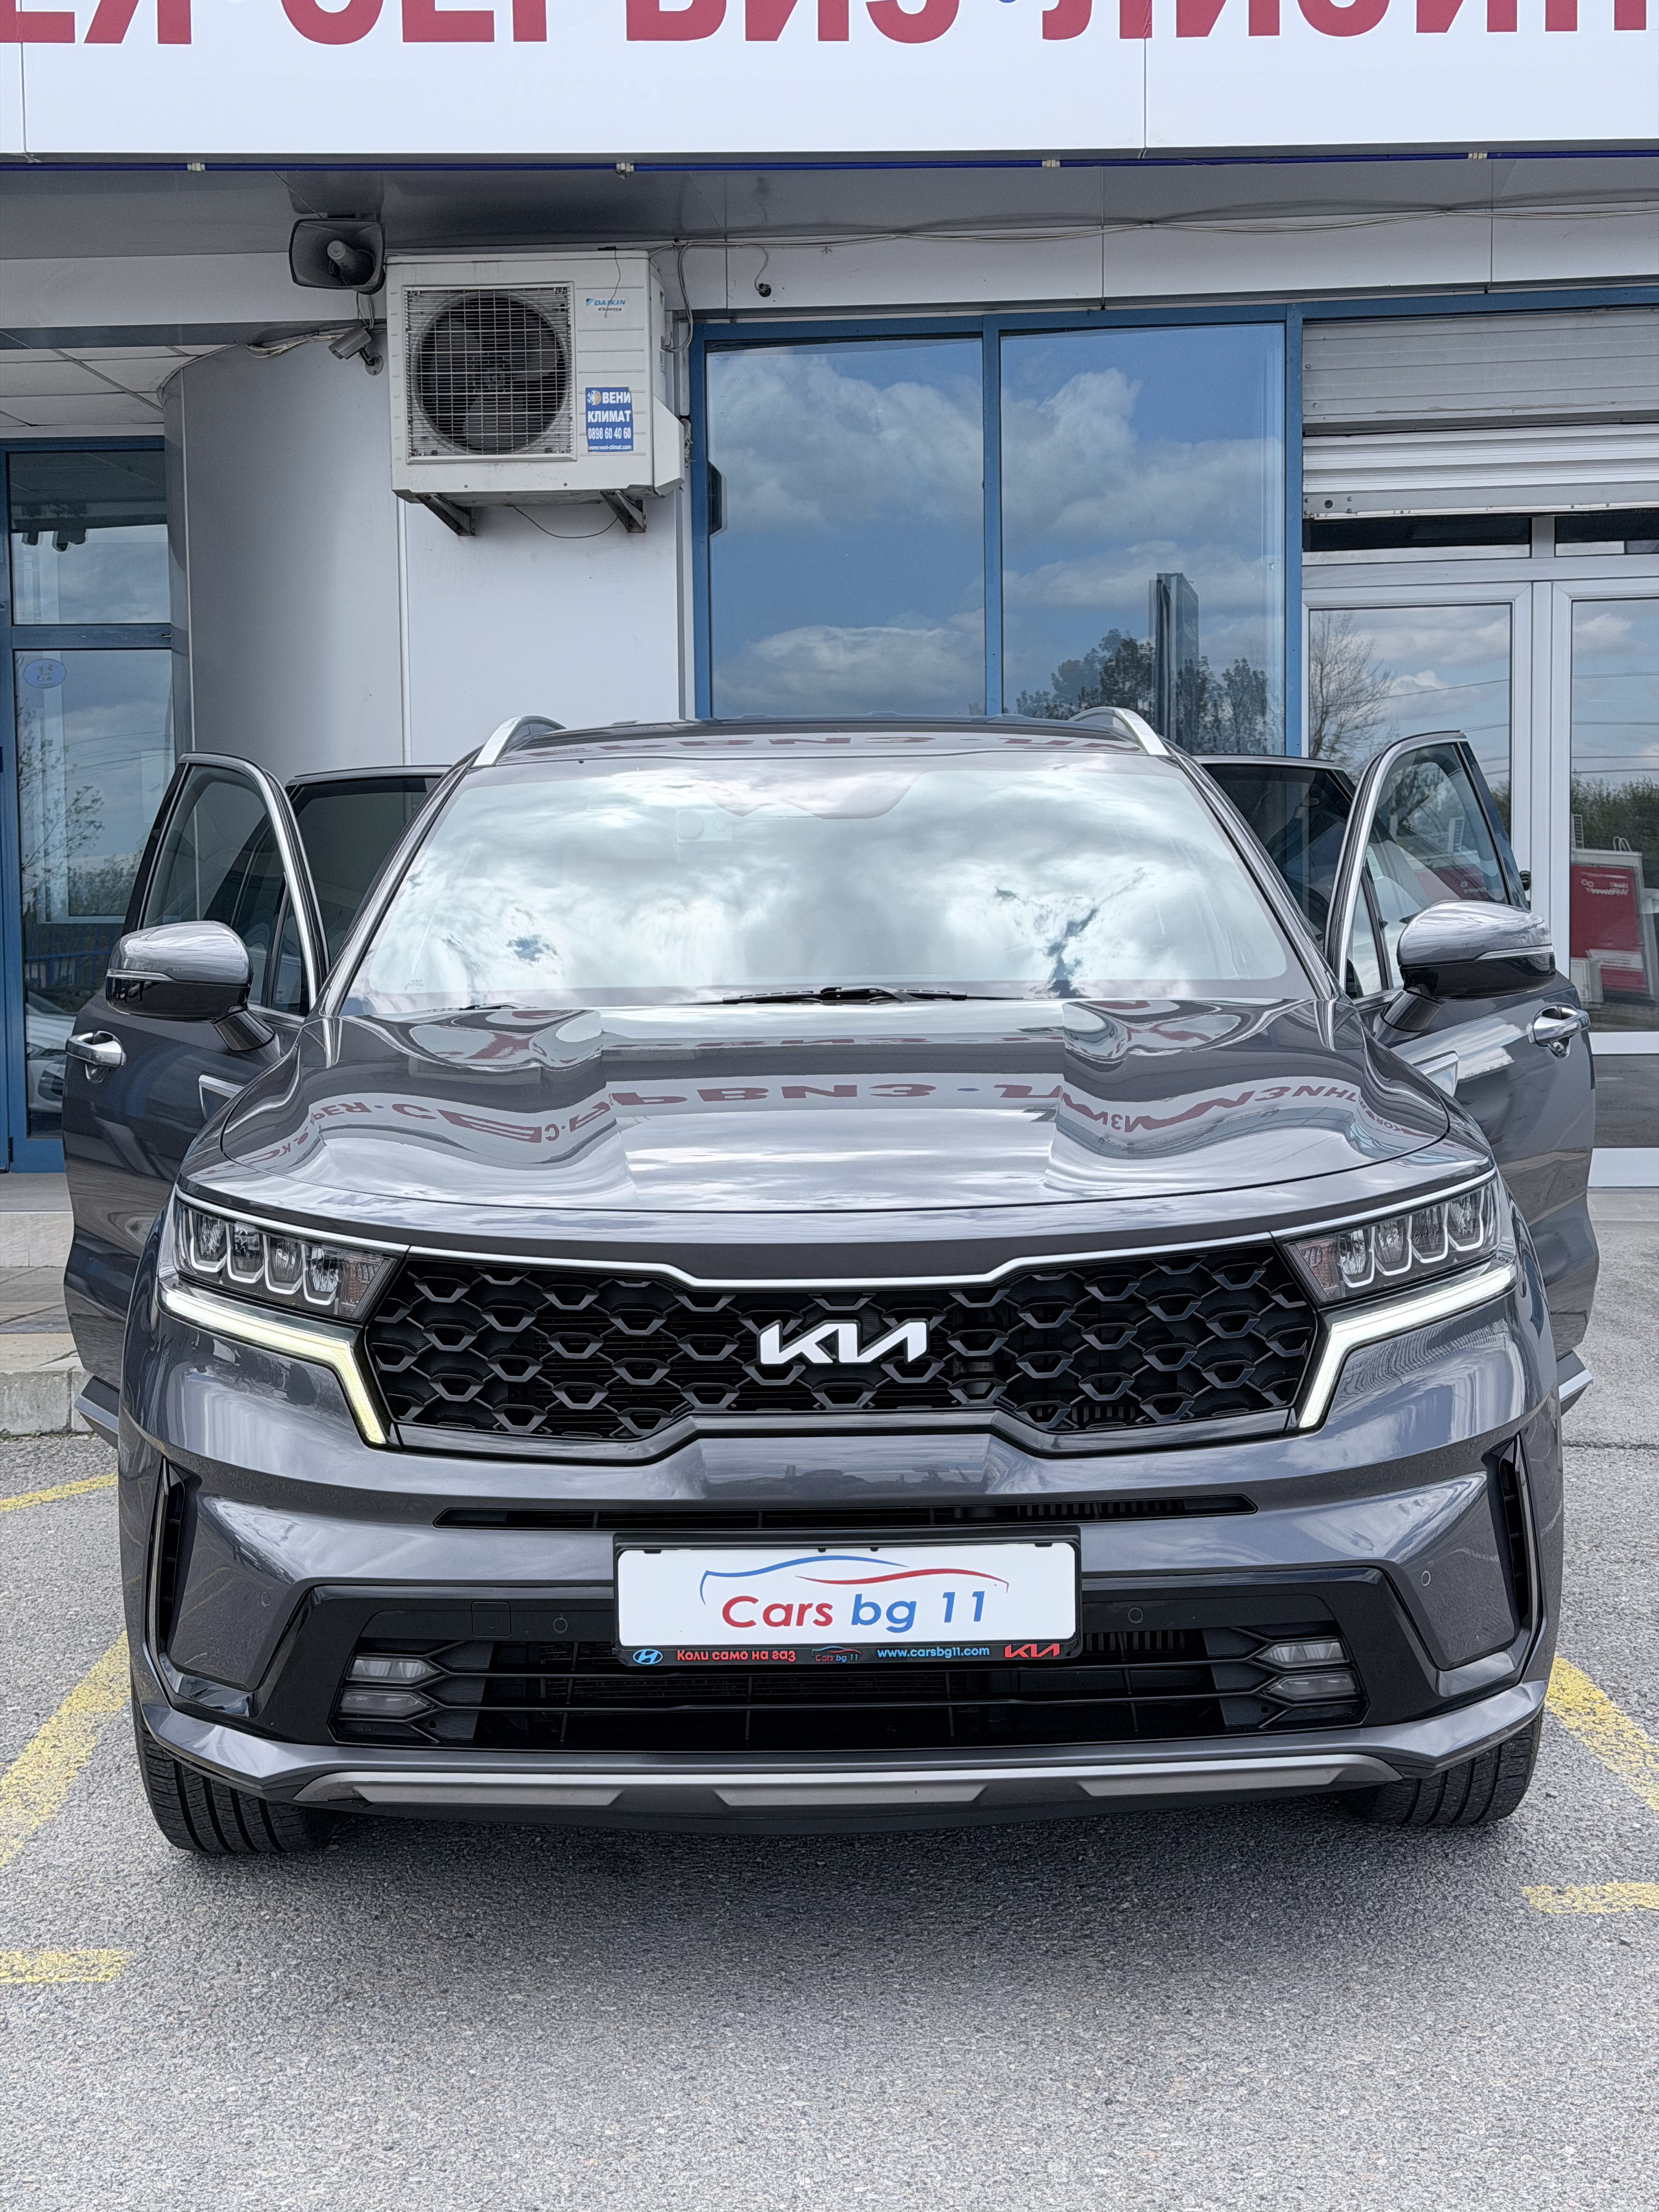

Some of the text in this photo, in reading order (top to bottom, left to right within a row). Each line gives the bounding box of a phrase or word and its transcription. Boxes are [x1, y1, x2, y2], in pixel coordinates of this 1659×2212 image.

[602, 391, 631, 404] ВЕНИ
[588, 410, 631, 423] КЛИМАТ
[588, 427, 631, 439] 0898 60 40 60
[760, 1322, 927, 1364] KIA
[722, 1590, 985, 1633] Cars bg 11
[676, 1650, 709, 1661] Коли
[712, 1650, 748, 1660] само
[752, 1650, 768, 1660] на
[877, 1646, 990, 1658] www.carsbg11.com
[1004, 1644, 1060, 1658] KIA
